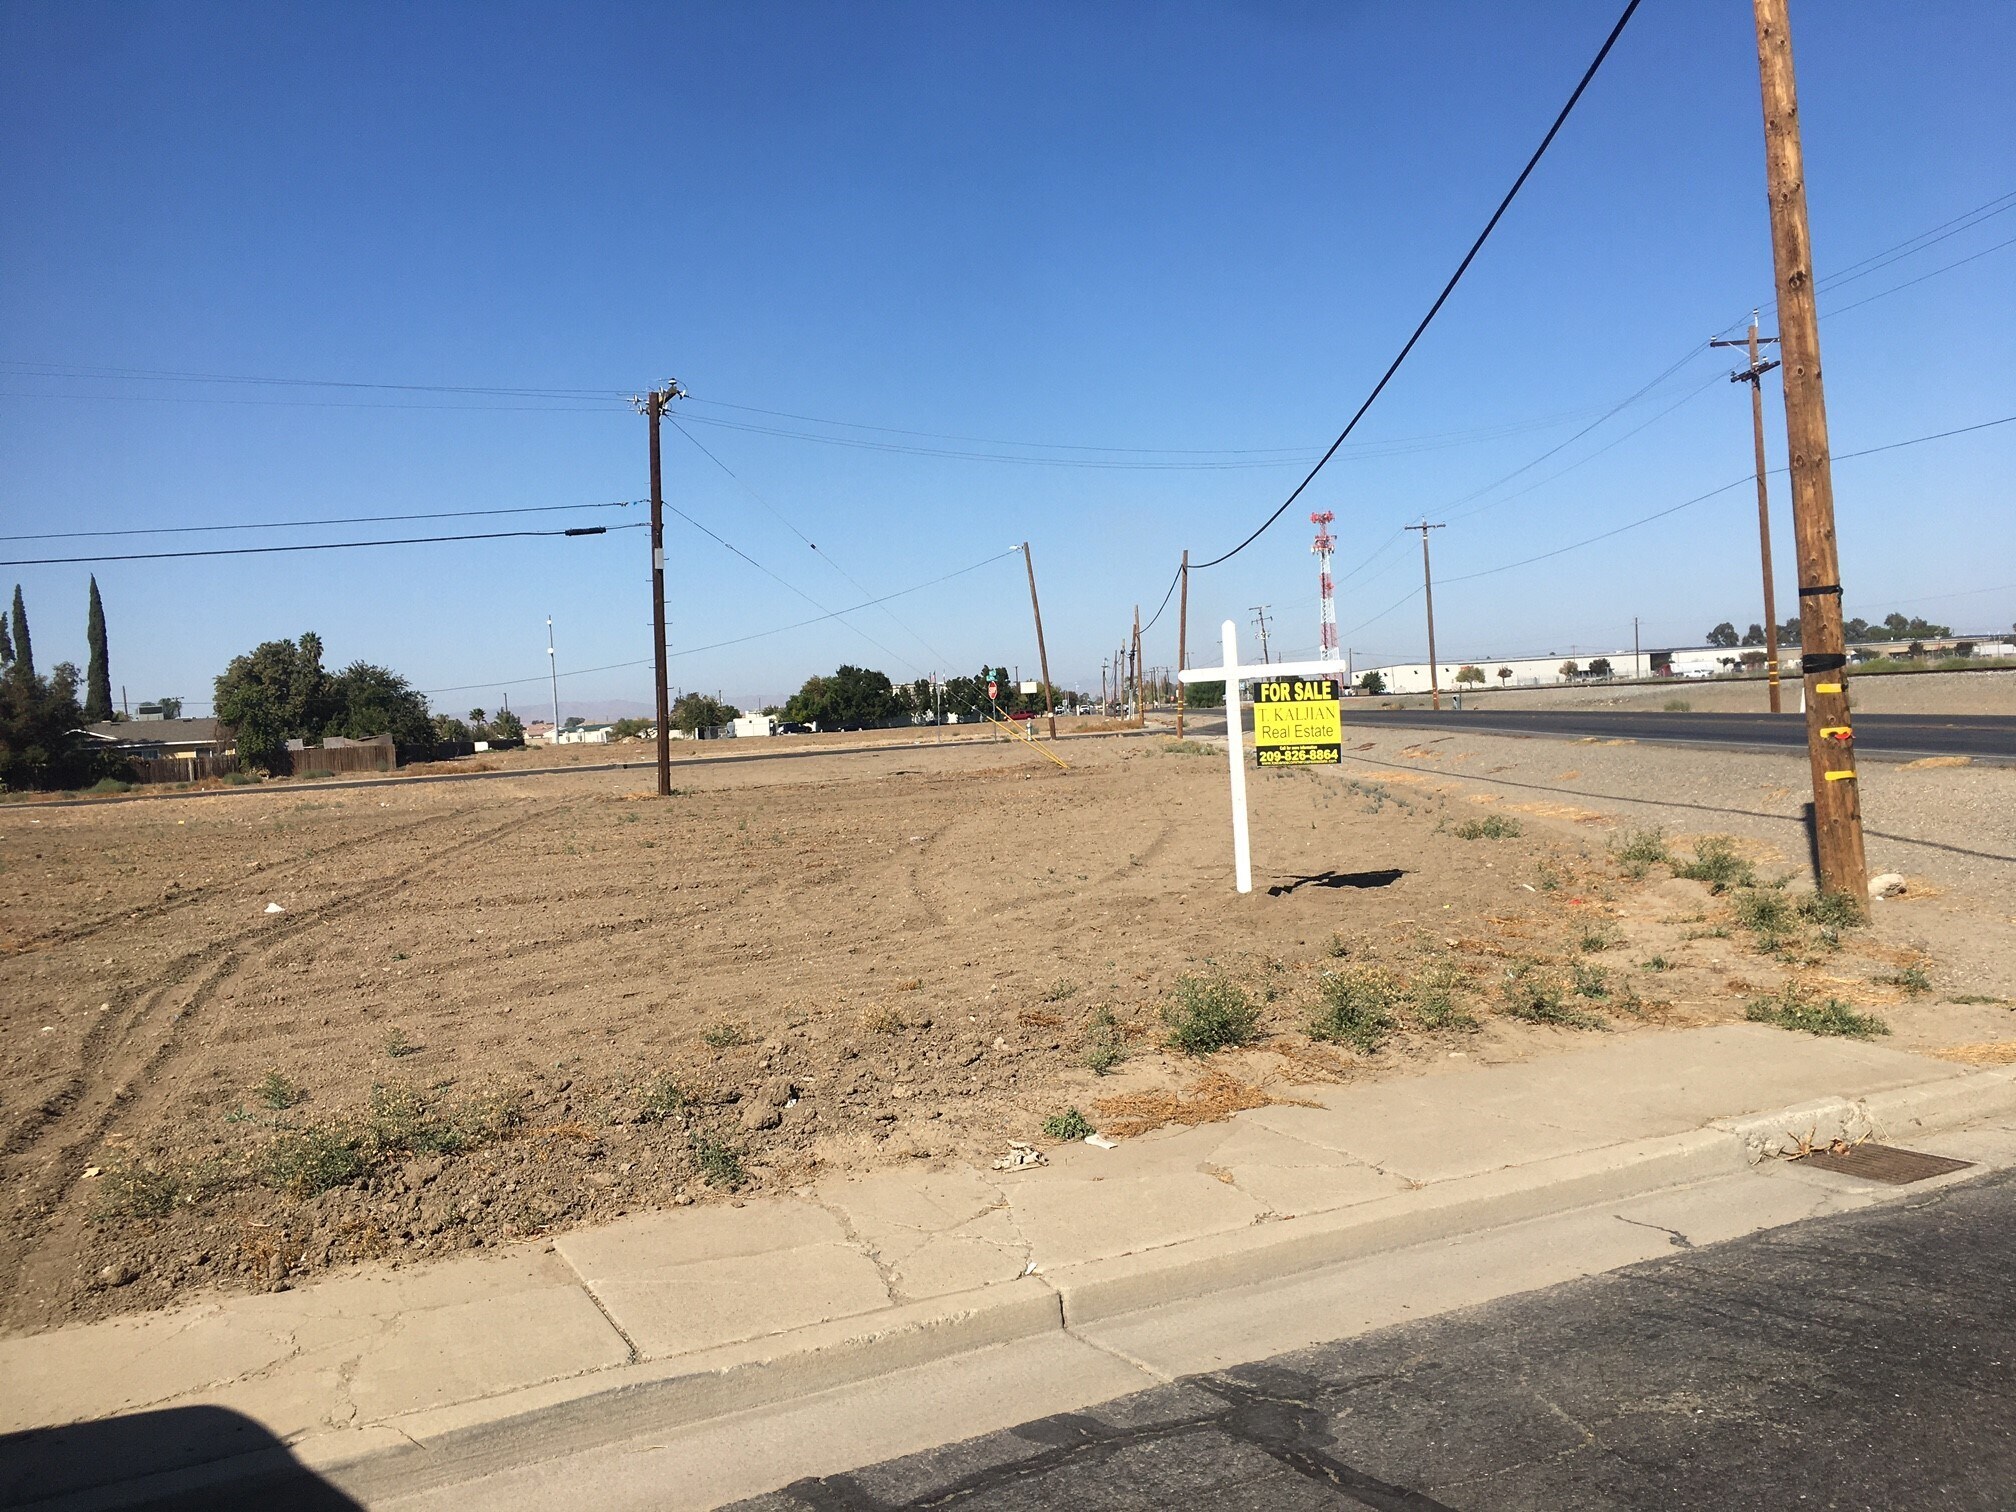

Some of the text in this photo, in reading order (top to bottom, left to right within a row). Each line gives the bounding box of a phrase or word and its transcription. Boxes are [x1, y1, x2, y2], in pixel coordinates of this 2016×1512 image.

[1261, 681, 1331, 702] FOR SALE
[1259, 707, 1335, 722] T. KALJIAN
[1262, 724, 1333, 738] Real Estate
[1260, 749, 1338, 761] 209-826-8864
